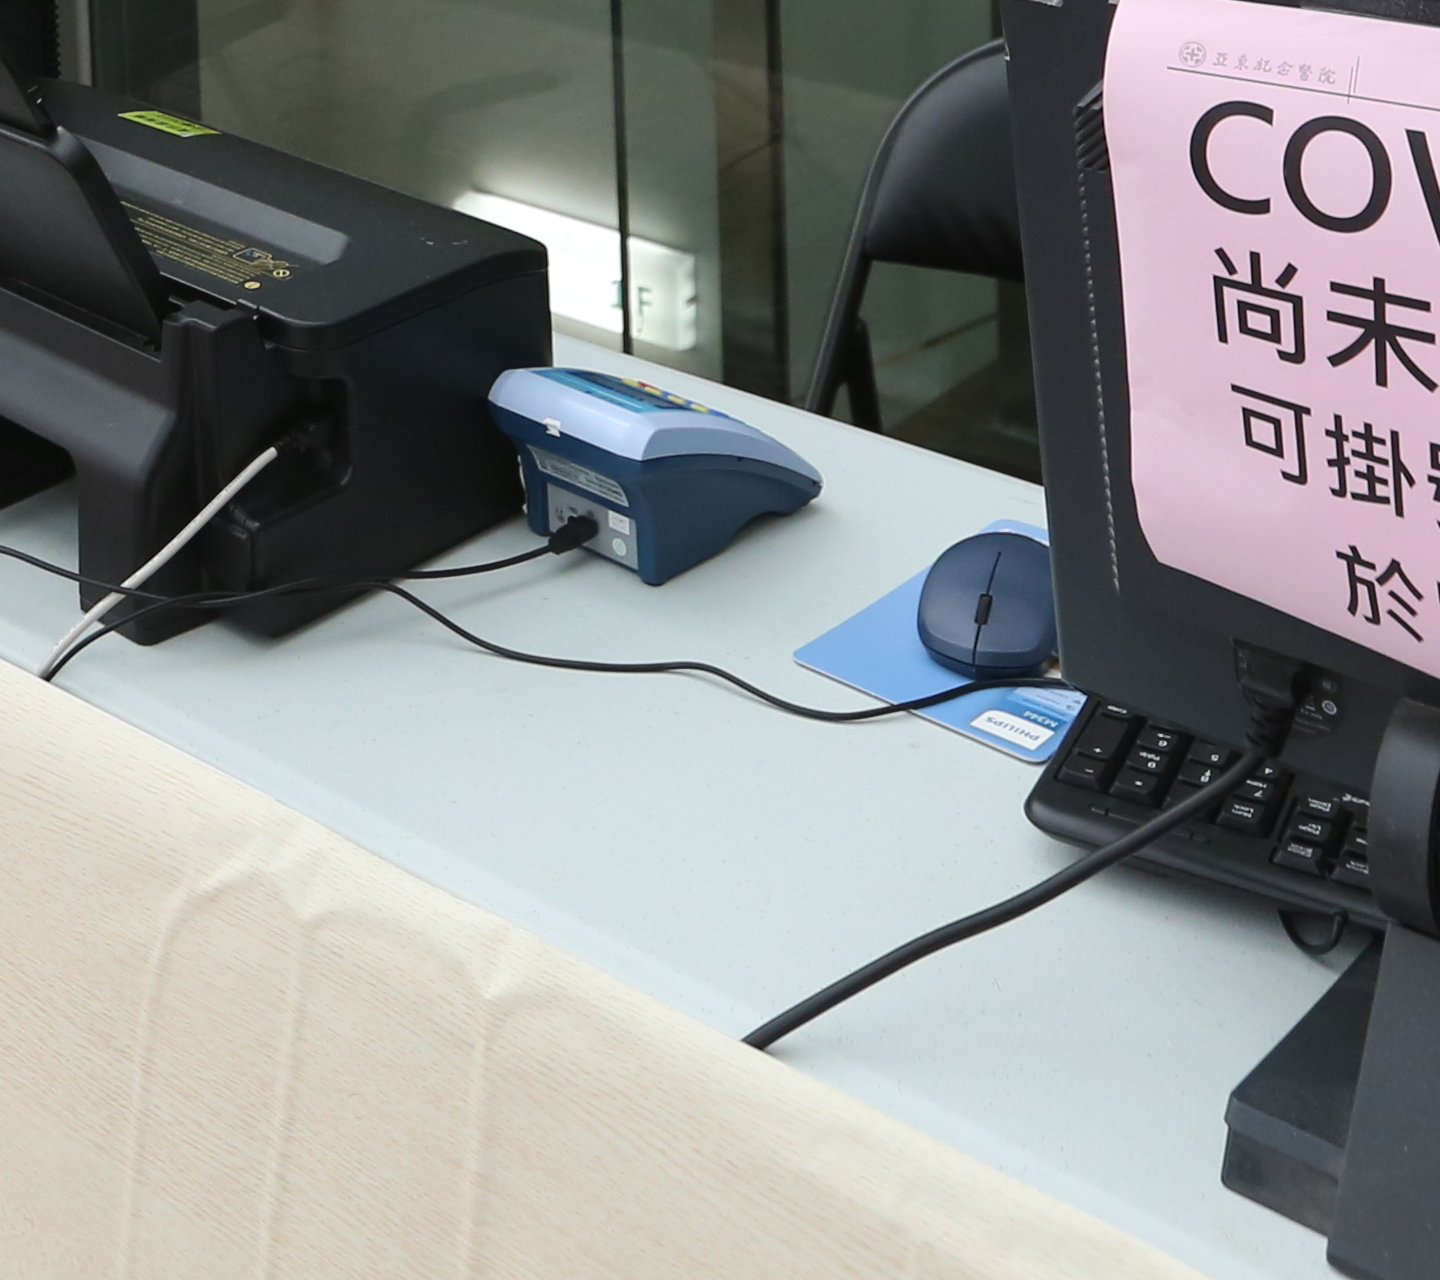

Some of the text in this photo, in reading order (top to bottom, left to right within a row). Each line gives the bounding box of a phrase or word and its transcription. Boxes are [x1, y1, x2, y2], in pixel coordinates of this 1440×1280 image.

[1212, 52, 1337, 85] 亞東紀念醫院
[984, 716, 1042, 741] PHILIPS
